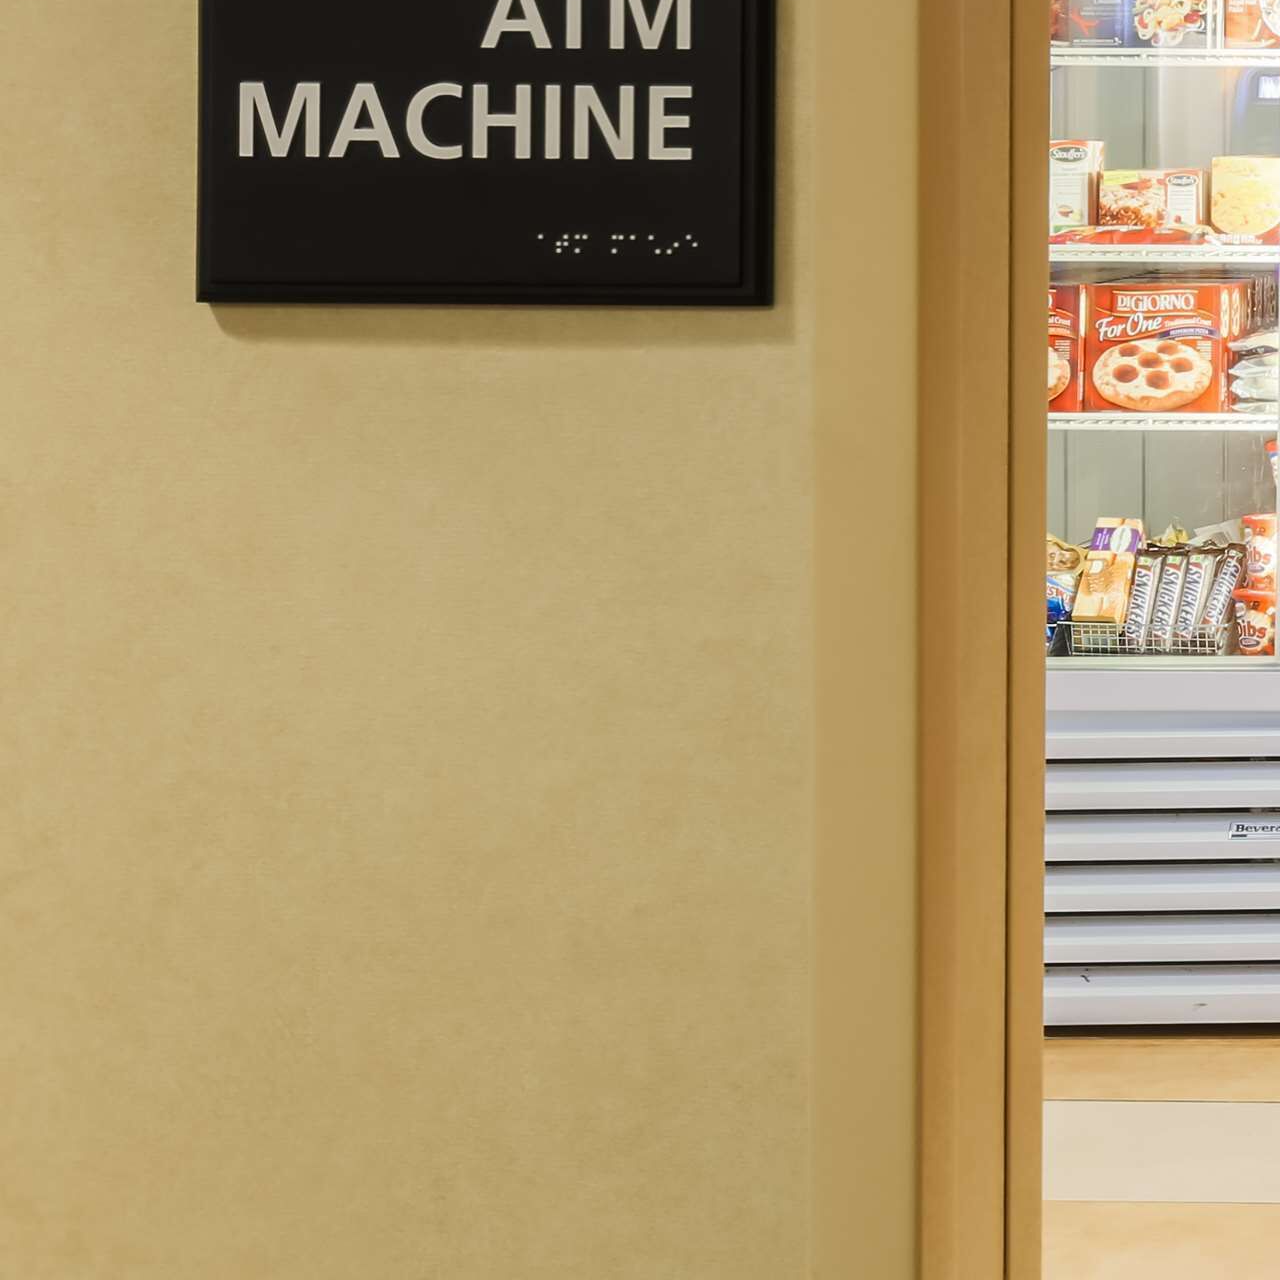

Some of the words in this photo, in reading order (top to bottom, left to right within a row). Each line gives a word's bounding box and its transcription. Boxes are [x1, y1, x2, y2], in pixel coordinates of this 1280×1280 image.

[238, 81, 693, 161] MACHINE
[1095, 315, 1127, 342] For
[1126, 312, 1163, 337] One
[1127, 566, 1153, 641] SNICKERS
[1153, 565, 1180, 640] SNICKERS
[1176, 564, 1204, 639] SNICKERS
